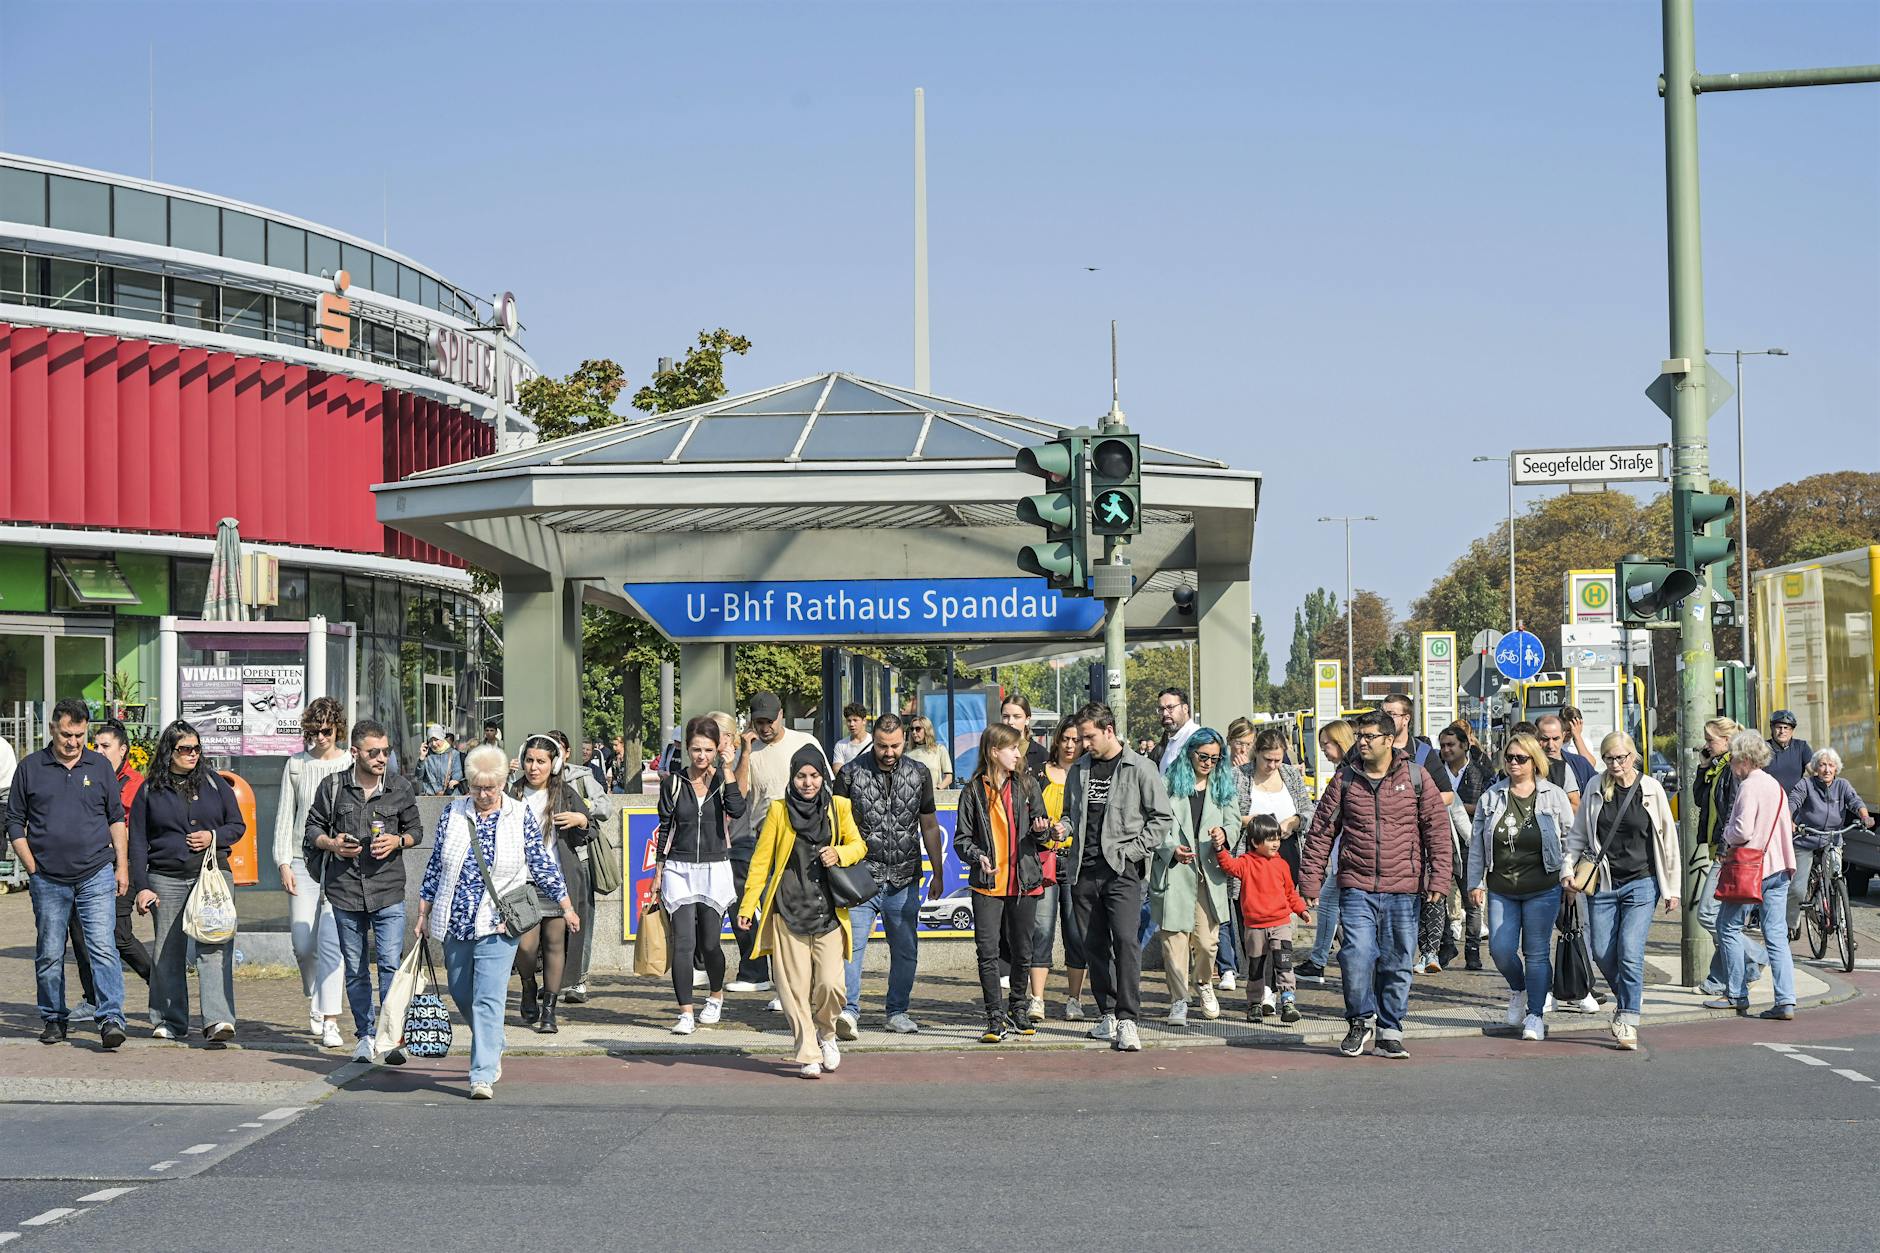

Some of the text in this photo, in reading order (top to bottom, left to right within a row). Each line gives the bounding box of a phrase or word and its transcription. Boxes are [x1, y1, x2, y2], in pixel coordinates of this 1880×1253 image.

[1522, 453, 1653, 476] Seegefelder Straße
[687, 587, 1057, 627] U-Bhf Rathaus Spandau
[182, 667, 242, 681] VIVALDI
[243, 668, 303, 677] OPERETTEN
[277, 678, 301, 686] GALA
[1540, 690, 1559, 705] M36
